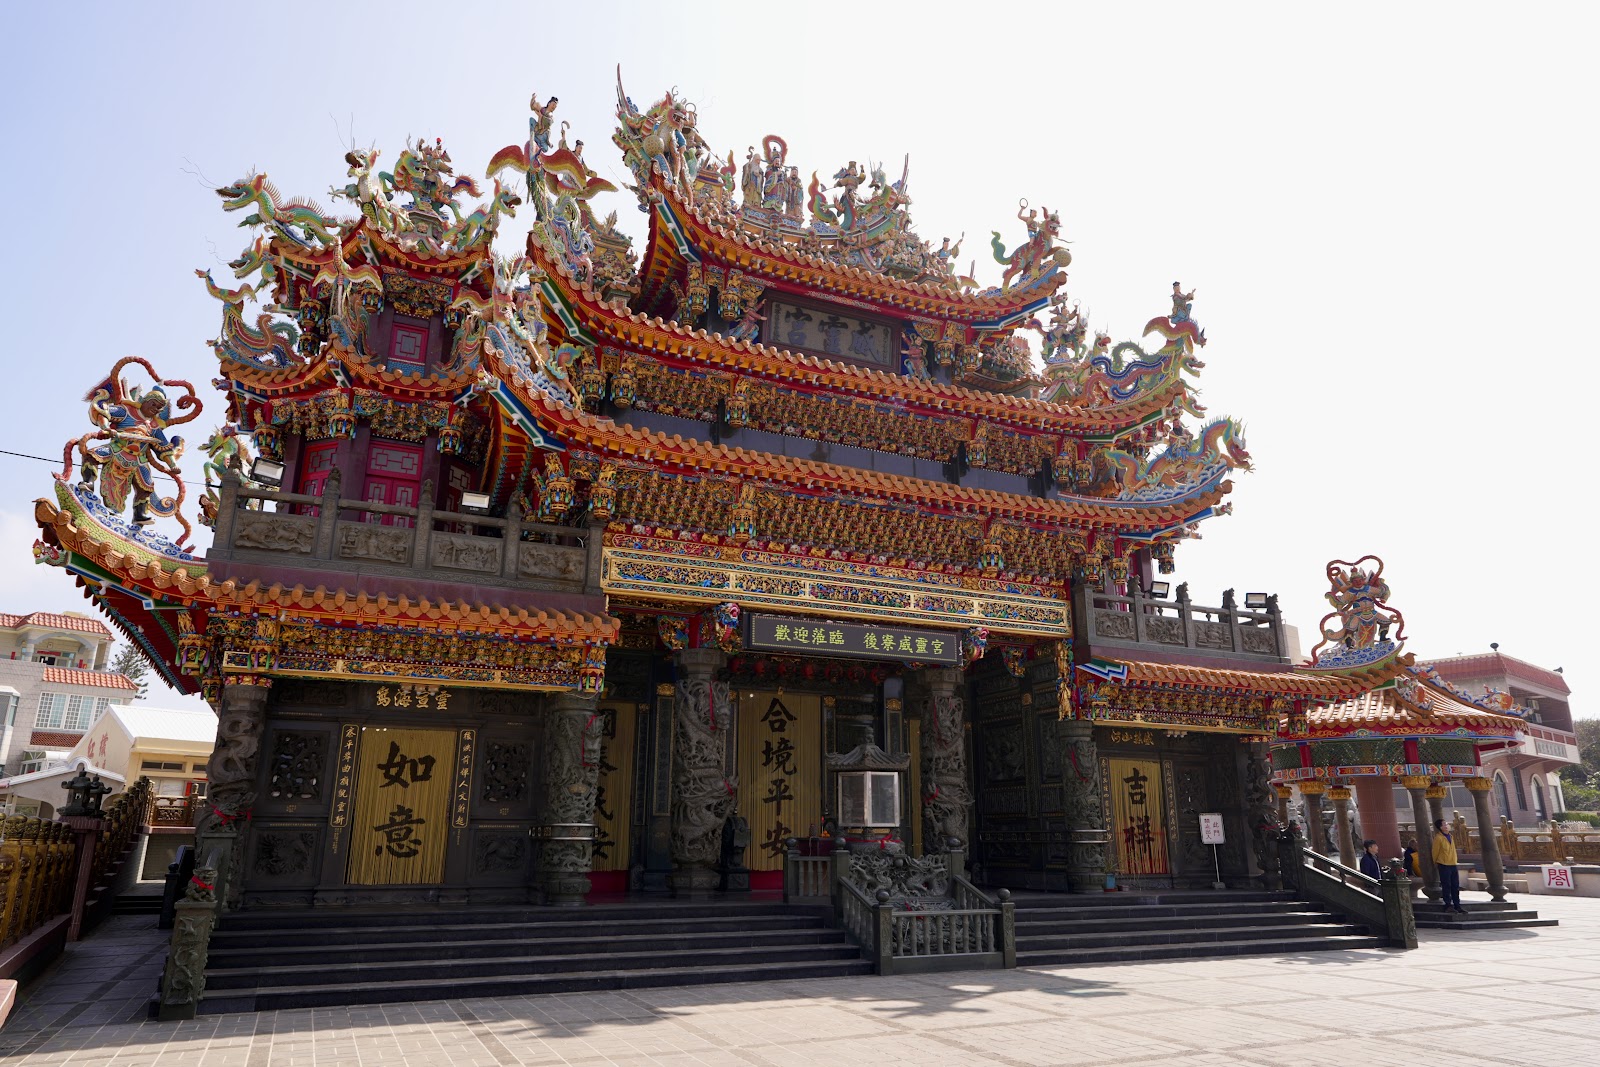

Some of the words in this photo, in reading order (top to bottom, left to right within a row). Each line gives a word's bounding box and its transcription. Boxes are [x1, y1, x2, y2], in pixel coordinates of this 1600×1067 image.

[774, 624, 845, 645] 歡迎蒞臨
[863, 632, 944, 655] 後寮威靈宮
[373, 741, 436, 858] 如意
[760, 697, 798, 858] 合境平安
[1123, 768, 1155, 854] 吉祥
